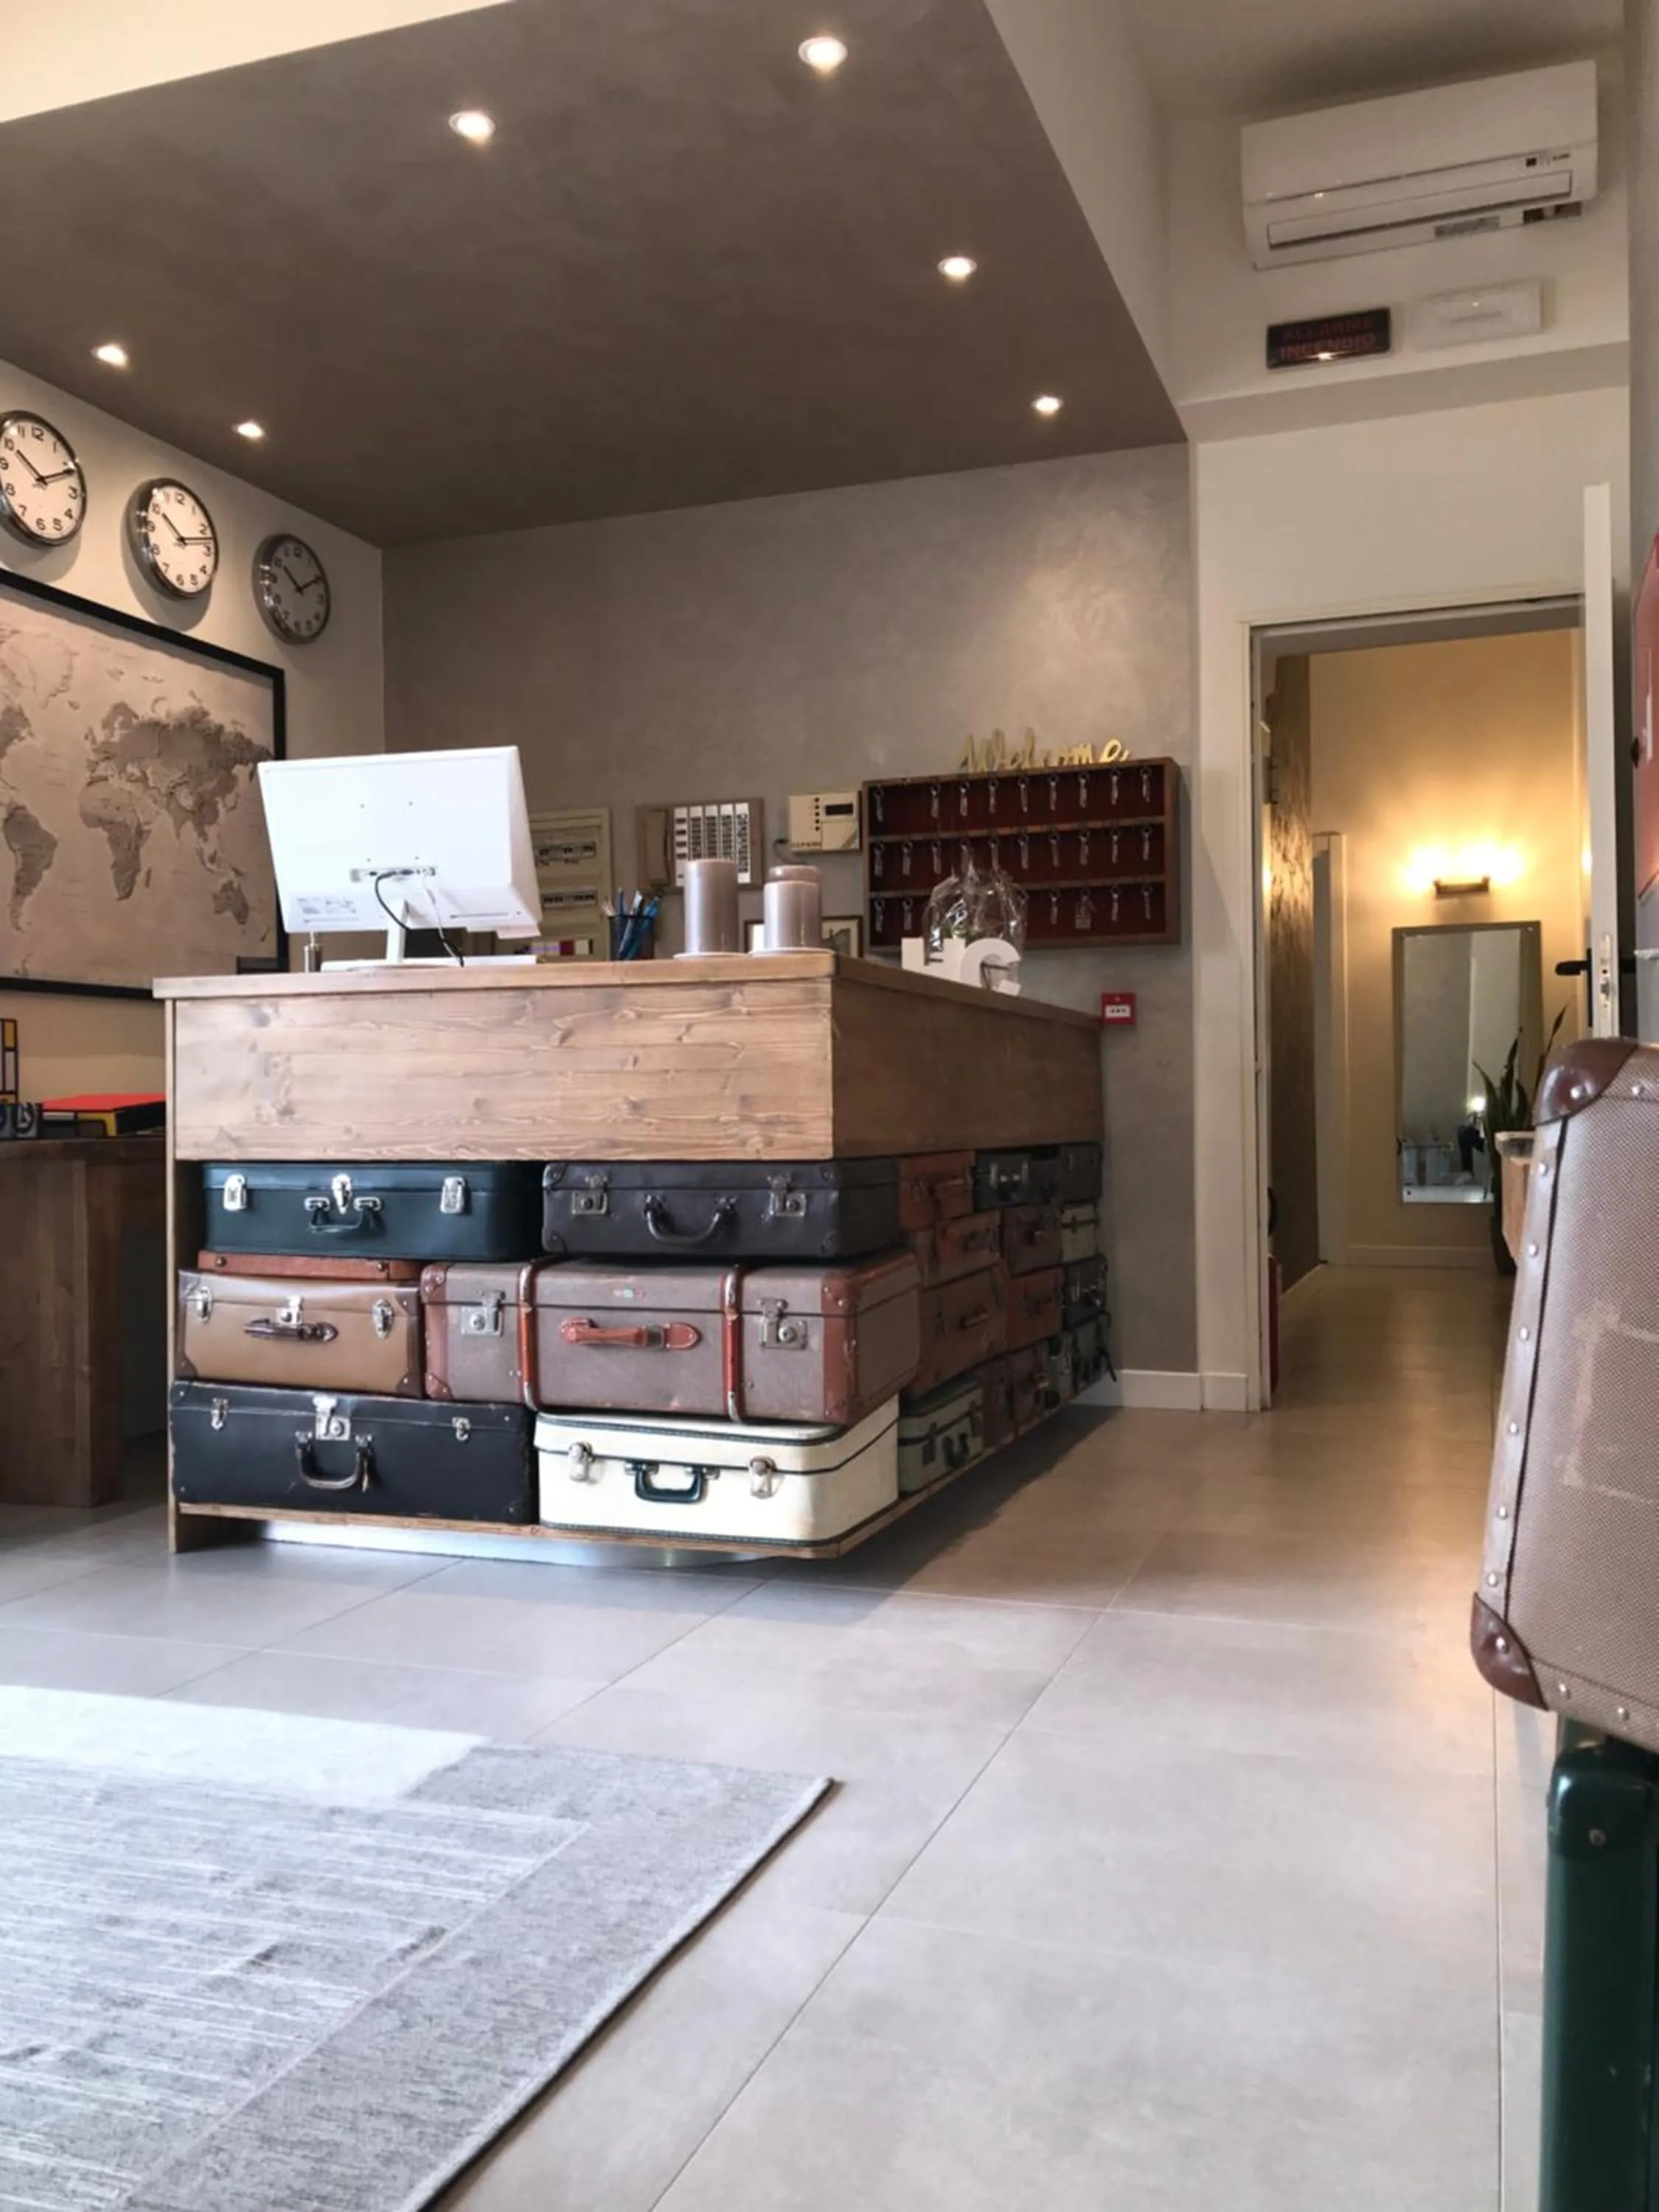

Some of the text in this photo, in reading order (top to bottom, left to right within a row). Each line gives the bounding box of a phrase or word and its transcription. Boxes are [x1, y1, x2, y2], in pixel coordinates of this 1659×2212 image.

[31, 426, 44, 442] 12
[4, 437, 15, 451] 10
[0, 457, 9, 471] 9
[5, 483, 15, 497] 8
[68, 486, 77, 500] 3
[18, 504, 27, 518] 7
[64, 507, 74, 521] 4
[35, 518, 46, 532] 6
[161, 562, 170, 574] 7
